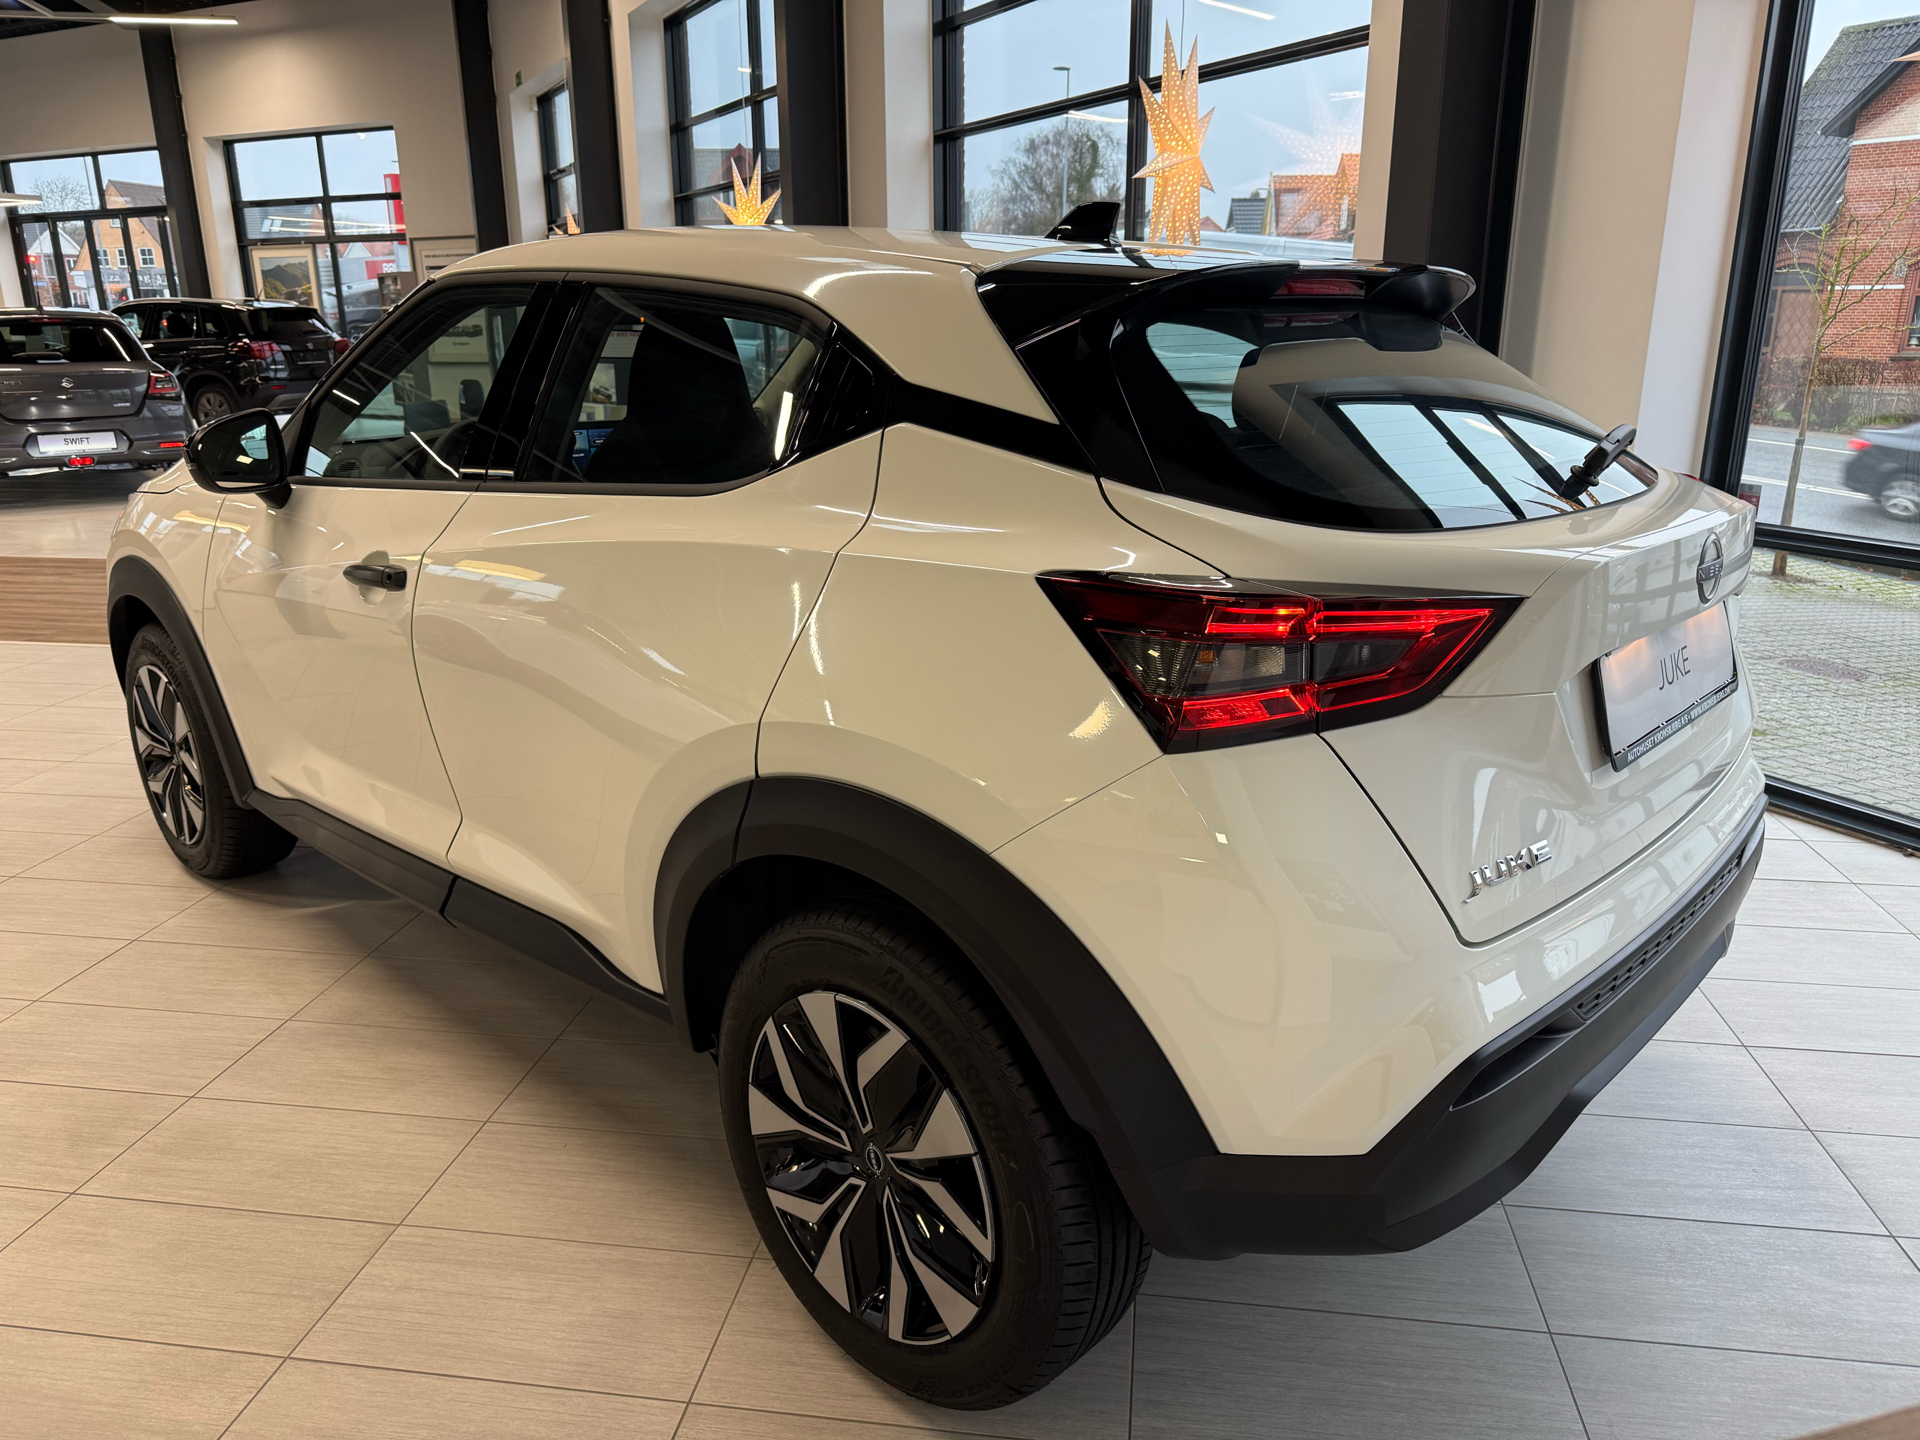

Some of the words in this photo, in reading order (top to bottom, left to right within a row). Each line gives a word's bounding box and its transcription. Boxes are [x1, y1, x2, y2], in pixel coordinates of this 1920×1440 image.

[63, 437, 91, 446] SWIFT
[141, 636, 183, 690] BRIDGESTONE
[1659, 645, 1691, 691] JUKE
[1627, 737, 1655, 762] AUTOHUSET
[1654, 719, 1682, 743] KRONSBJERG
[1462, 839, 1552, 904] JUKE
